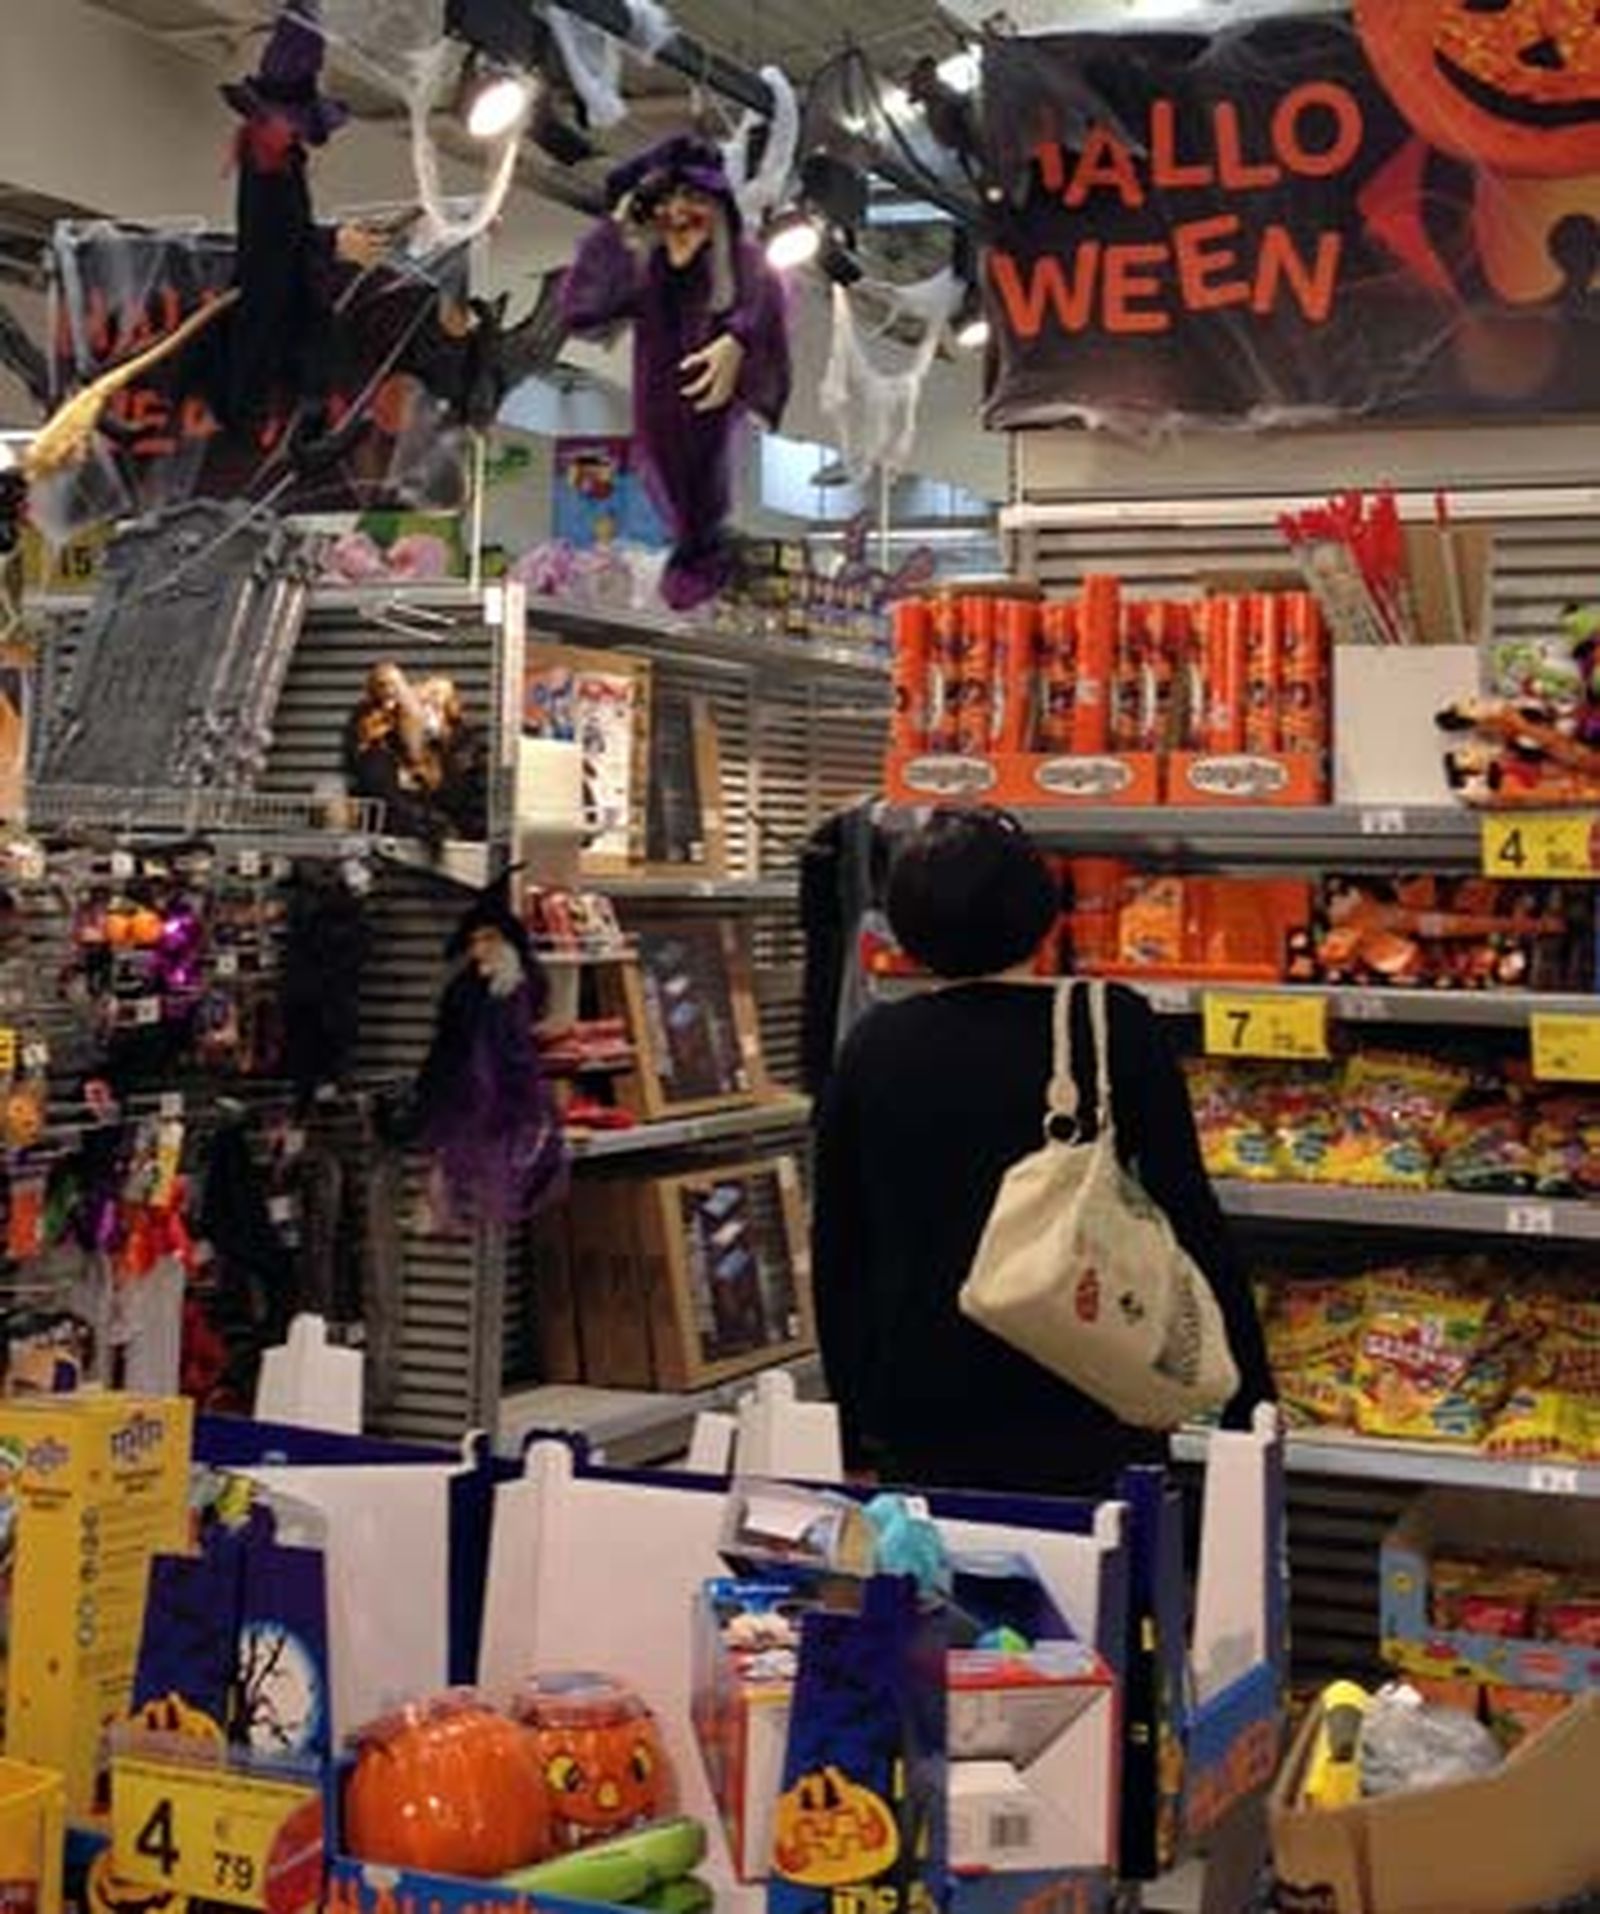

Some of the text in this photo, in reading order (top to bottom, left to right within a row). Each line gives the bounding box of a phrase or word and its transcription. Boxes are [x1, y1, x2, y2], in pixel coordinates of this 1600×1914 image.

[988, 214, 1342, 337] WEEN
[1499, 828, 1527, 870] 4
[1227, 1010, 1250, 1049] 7
[136, 1799, 180, 1876] 4
[214, 1851, 254, 1891] 79
